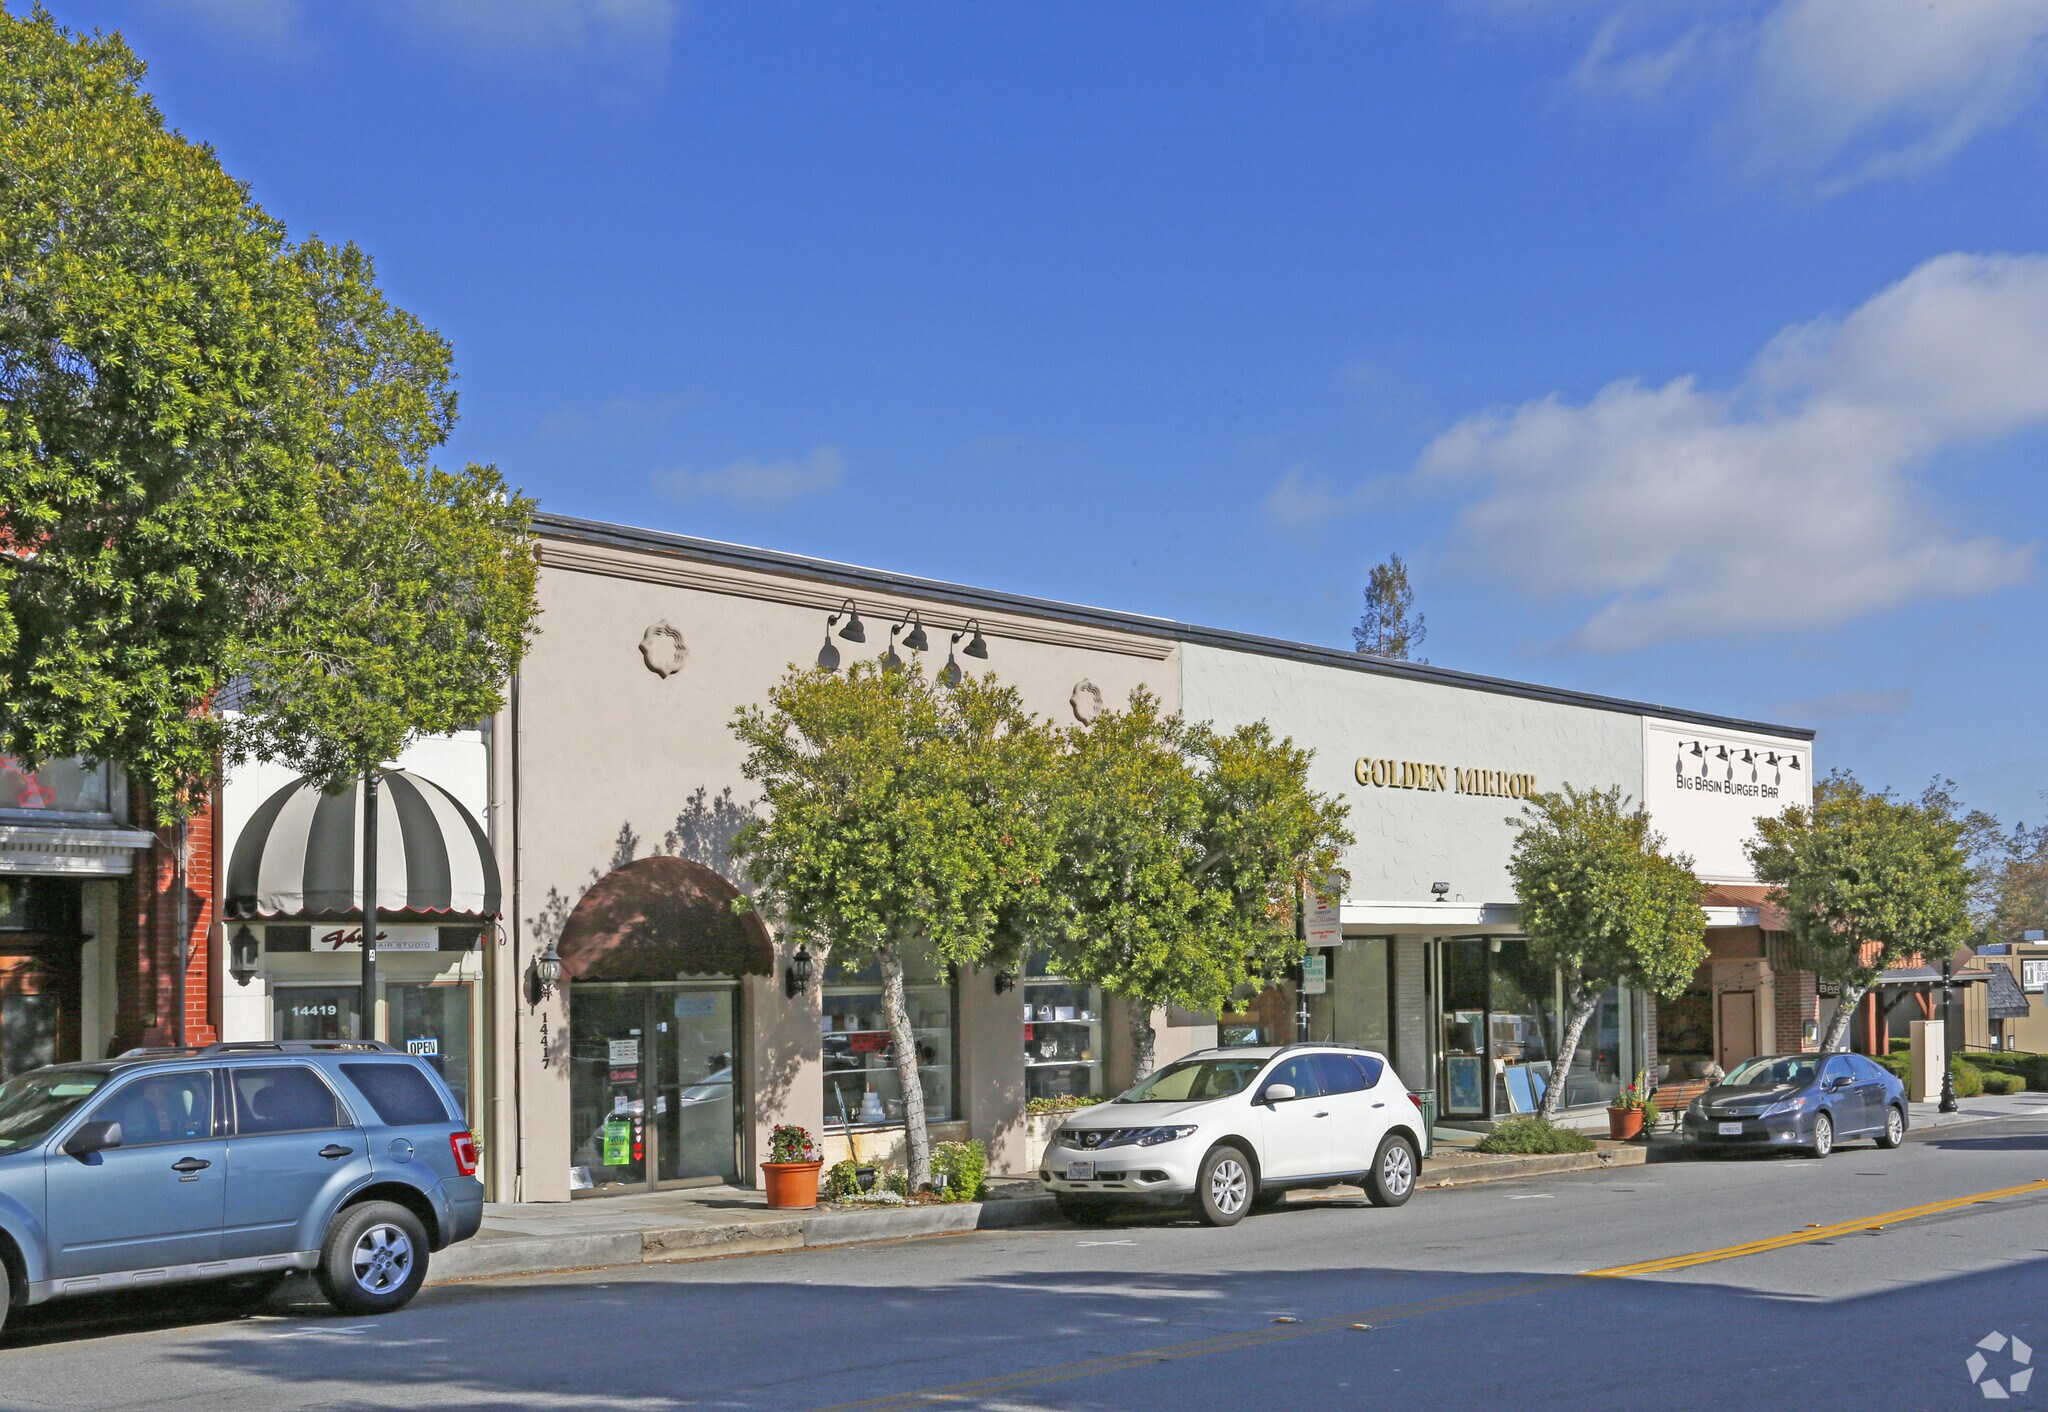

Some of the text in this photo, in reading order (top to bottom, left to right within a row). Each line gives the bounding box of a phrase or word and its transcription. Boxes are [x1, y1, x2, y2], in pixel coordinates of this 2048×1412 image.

[1355, 757, 1538, 799] GOLDEN MIRROR
[1305, 957, 1312, 967] 2
[1820, 985, 1840, 995] BAR
[291, 1005, 337, 1016] 14419
[410, 1040, 436, 1054] OPEN
[540, 1012, 550, 1070] 14417
